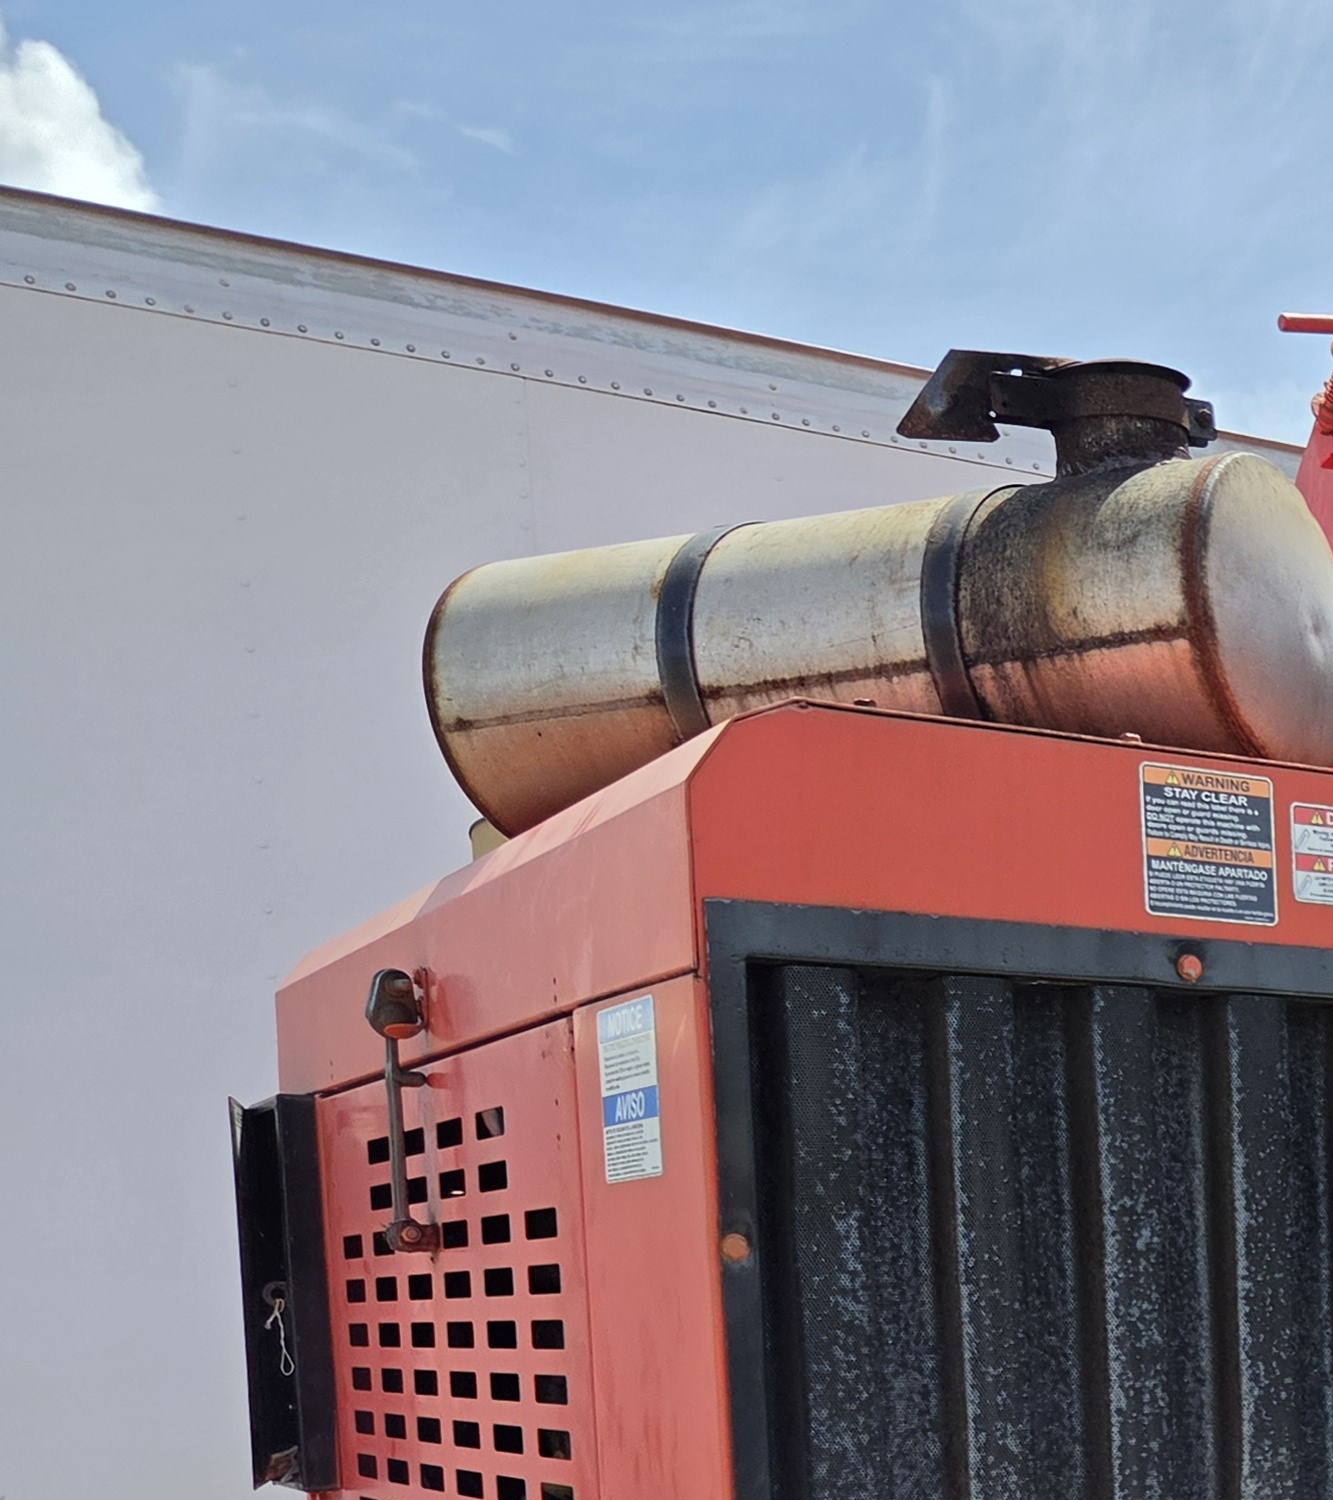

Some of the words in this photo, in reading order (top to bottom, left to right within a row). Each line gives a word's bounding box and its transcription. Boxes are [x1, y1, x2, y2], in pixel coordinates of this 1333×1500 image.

[1181, 772, 1250, 792] WARNING
[1163, 786, 1198, 800] STAY
[1201, 791, 1248, 807] CLEAR
[1184, 844, 1255, 864] ADVERTENCIA
[1219, 866, 1268, 881] APARTADO
[607, 1004, 643, 1037] NOTICE
[615, 1091, 645, 1122] AVISO
